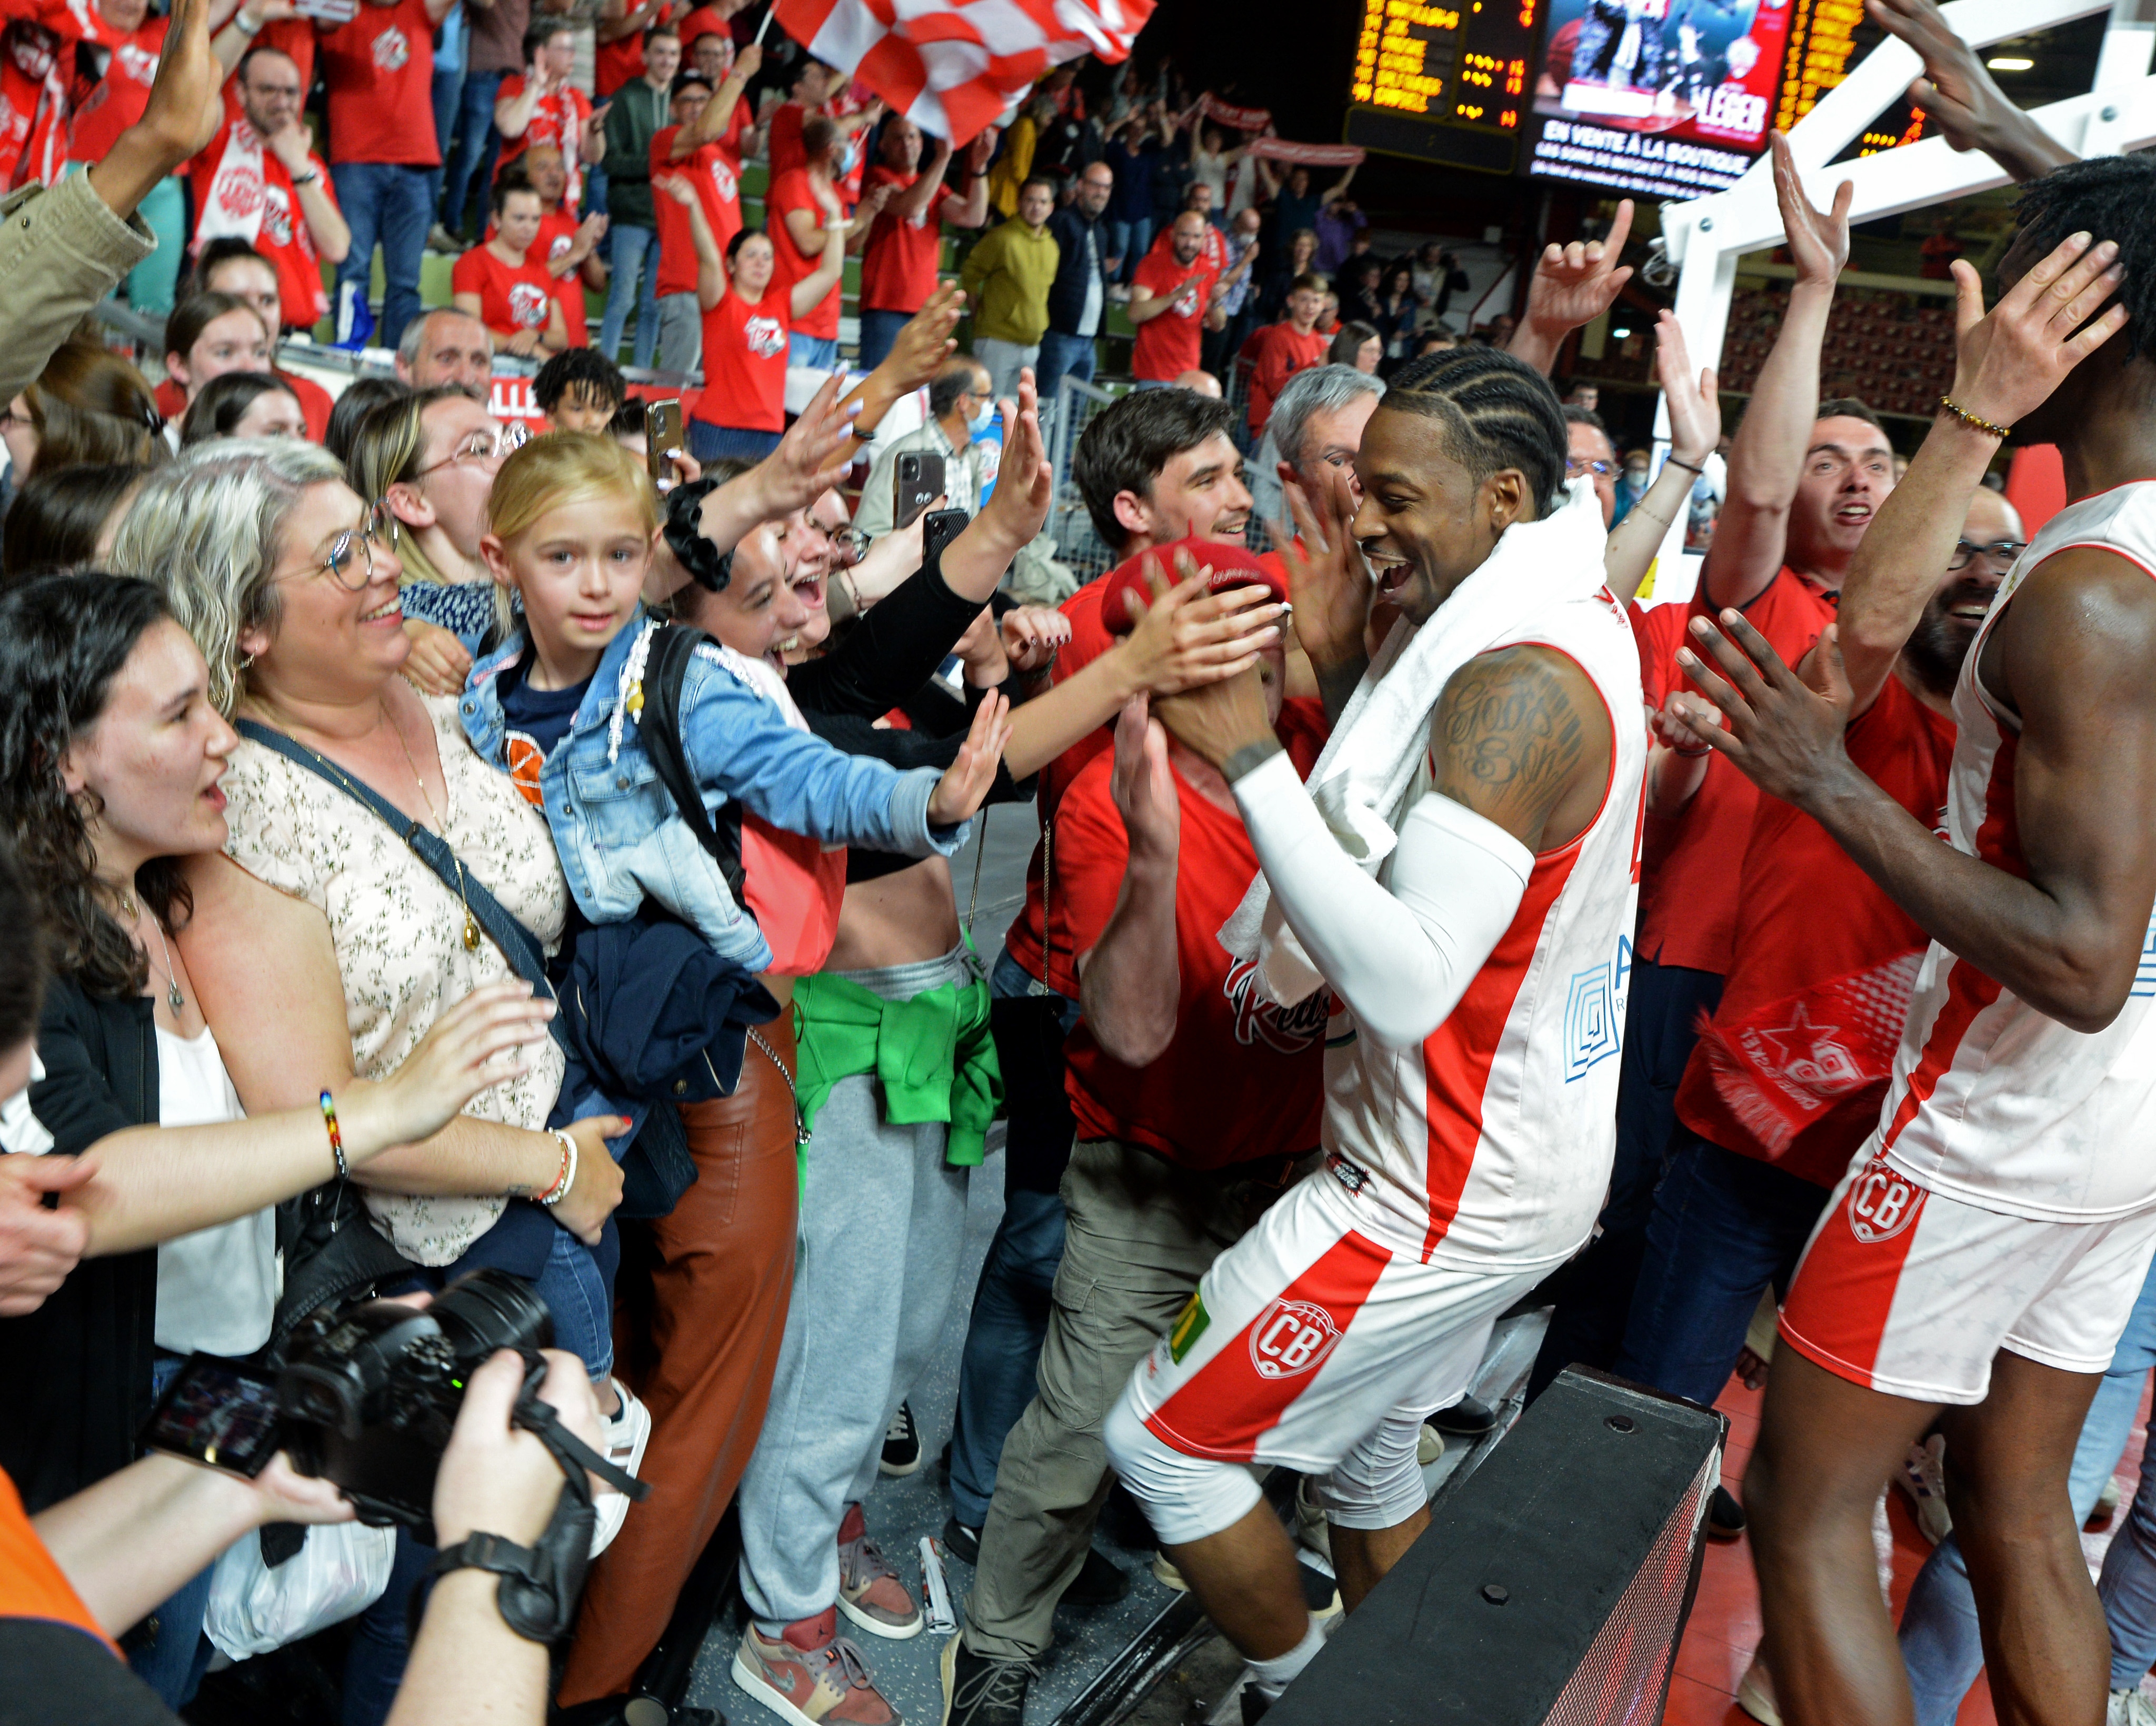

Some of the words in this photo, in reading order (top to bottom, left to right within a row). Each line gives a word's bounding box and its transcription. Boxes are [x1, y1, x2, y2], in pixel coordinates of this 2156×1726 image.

[1543, 120, 1571, 142] EN
[1571, 123, 1628, 154] VENTE
[1624, 131, 1641, 156] À
[1641, 137, 1665, 159] LA
[1665, 142, 1751, 176] BOUTIQUE
[487, 383, 544, 418] LLE
[1856, 1172, 1910, 1230] CB
[1259, 1314, 1323, 1368] CB
